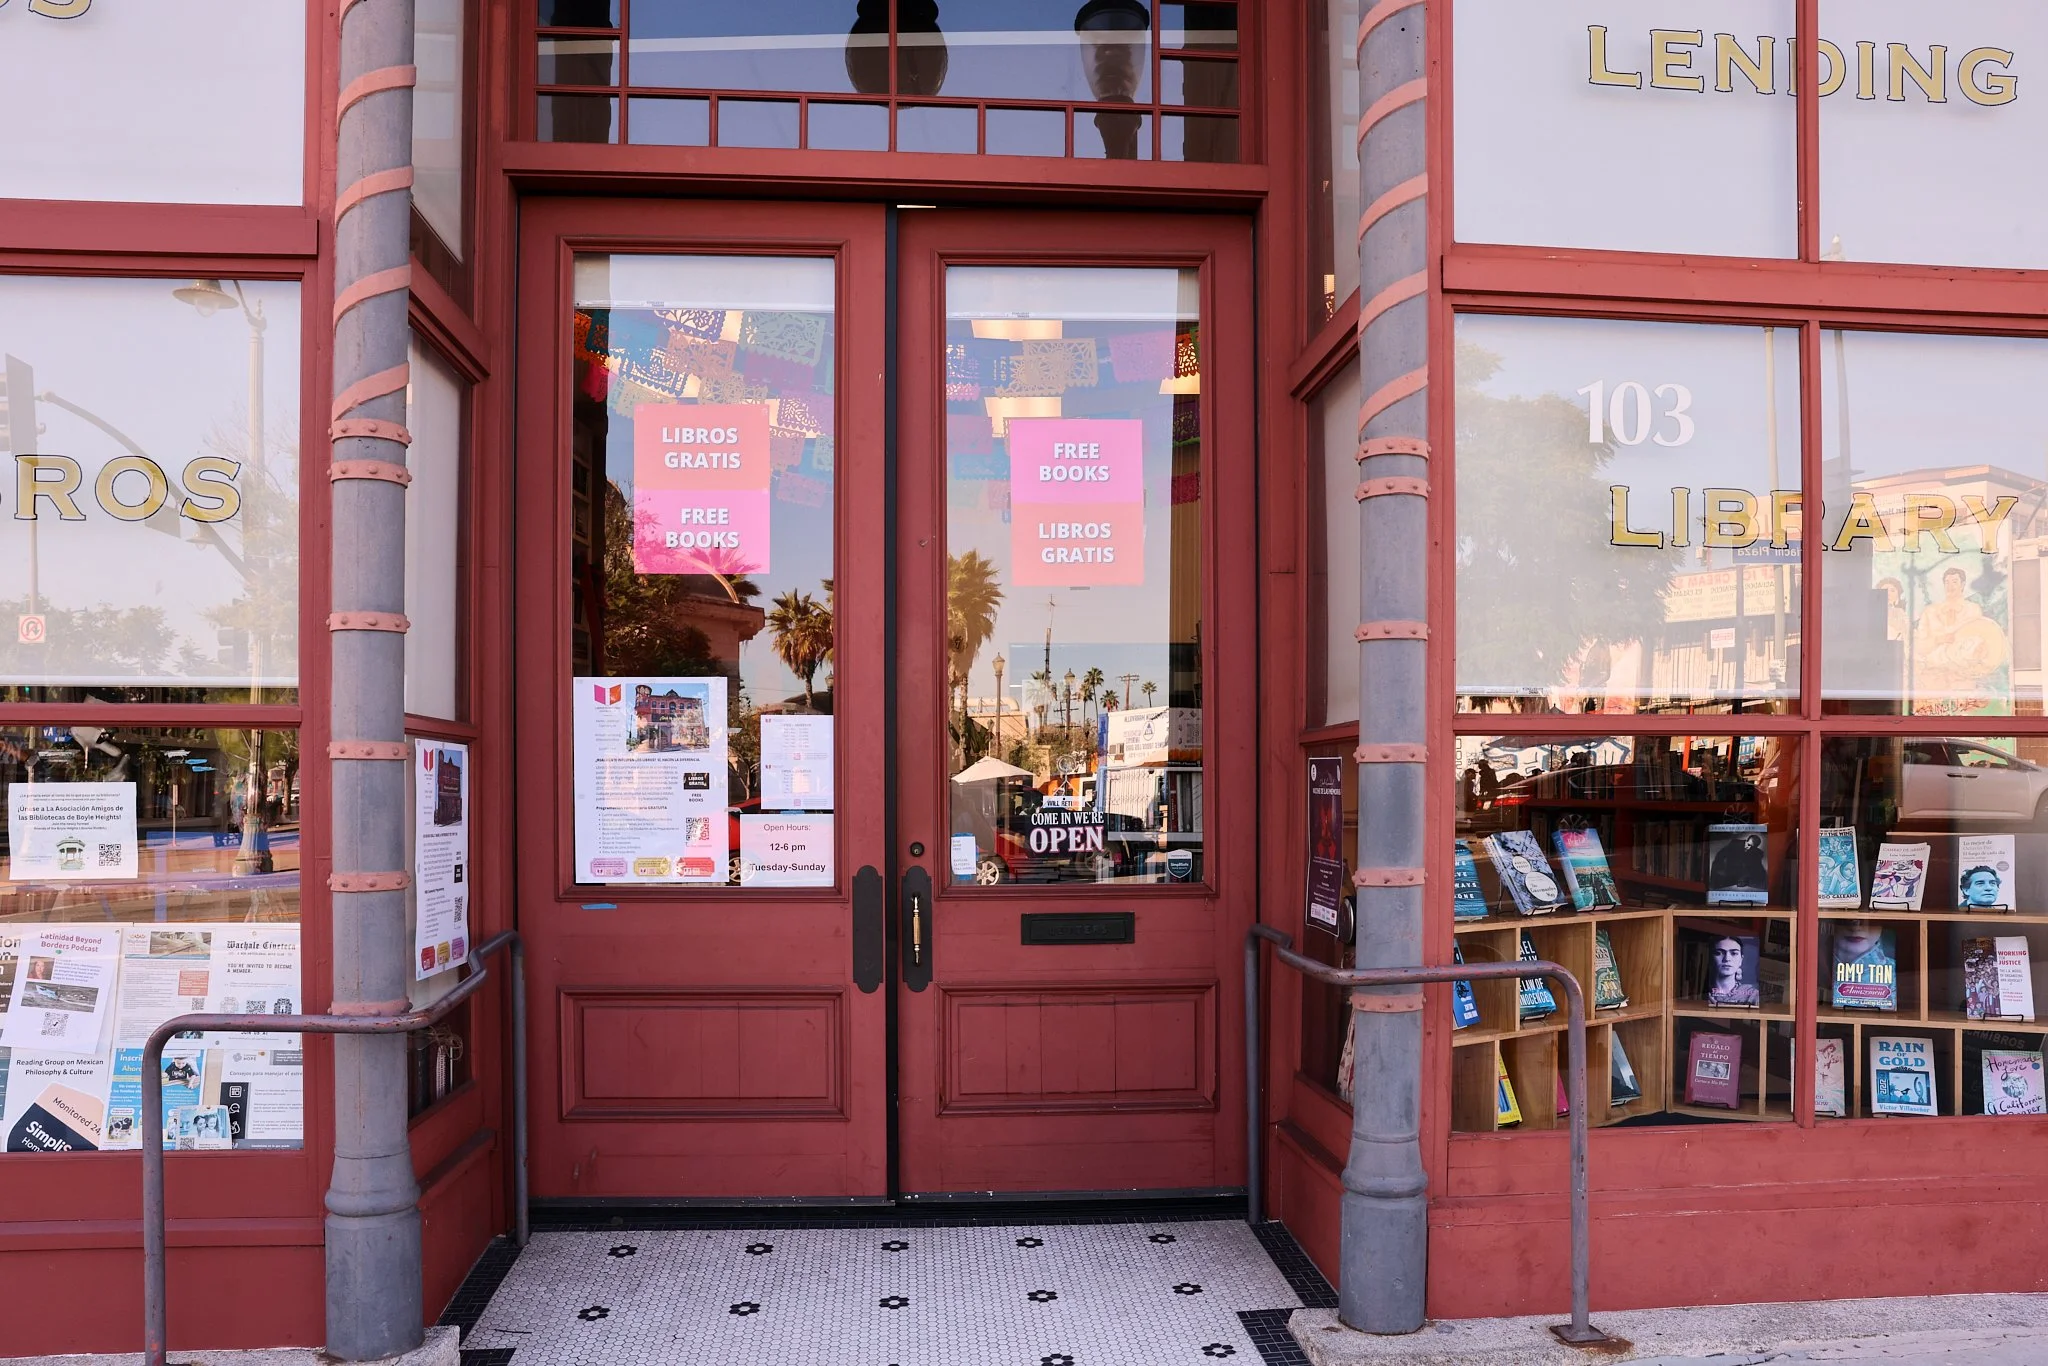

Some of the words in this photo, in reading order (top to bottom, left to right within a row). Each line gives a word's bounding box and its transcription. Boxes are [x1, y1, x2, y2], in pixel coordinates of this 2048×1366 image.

[1588, 25, 2018, 107] LENDING
[1577, 380, 1694, 447] 103
[662, 427, 738, 444] LIBROS
[1053, 442, 1100, 459] FREE
[664, 452, 741, 469] GRATIS
[1039, 465, 1110, 482] BOOKS
[0, 455, 241, 523] ROS
[680, 508, 729, 525] FREE
[1610, 485, 2019, 554] LIBRARY
[1038, 522, 1112, 539] LIBROS
[665, 531, 740, 549] BOOKS
[1041, 546, 1115, 563] GRATIS
[1031, 812, 1059, 826] COME
[1061, 812, 1070, 825] IN
[1073, 812, 1104, 824] WE'RE
[763, 824, 784, 832] Open
[769, 843, 789, 851] 12-6
[791, 844, 806, 852] pm
[1030, 826, 1105, 853] OPEN
[749, 863, 826, 872] Tuesday-Sunday
[40, 932, 74, 942] Latinidad
[75, 936, 102, 945] Beyond
[40, 940, 69, 950] Borders
[70, 943, 99, 952] Podcast
[1836, 962, 1864, 983] AMY
[1868, 964, 1893, 984] TAN
[1523, 978, 1536, 991] LAW
[1536, 978, 1544, 989] OF
[1702, 1043, 1730, 1051] REGALO
[1878, 1041, 1924, 1053] RAIN
[1701, 1052, 1729, 1060] TIEMPO
[1879, 1056, 1926, 1067] GOLD
[52, 1096, 92, 1127] Monitored
